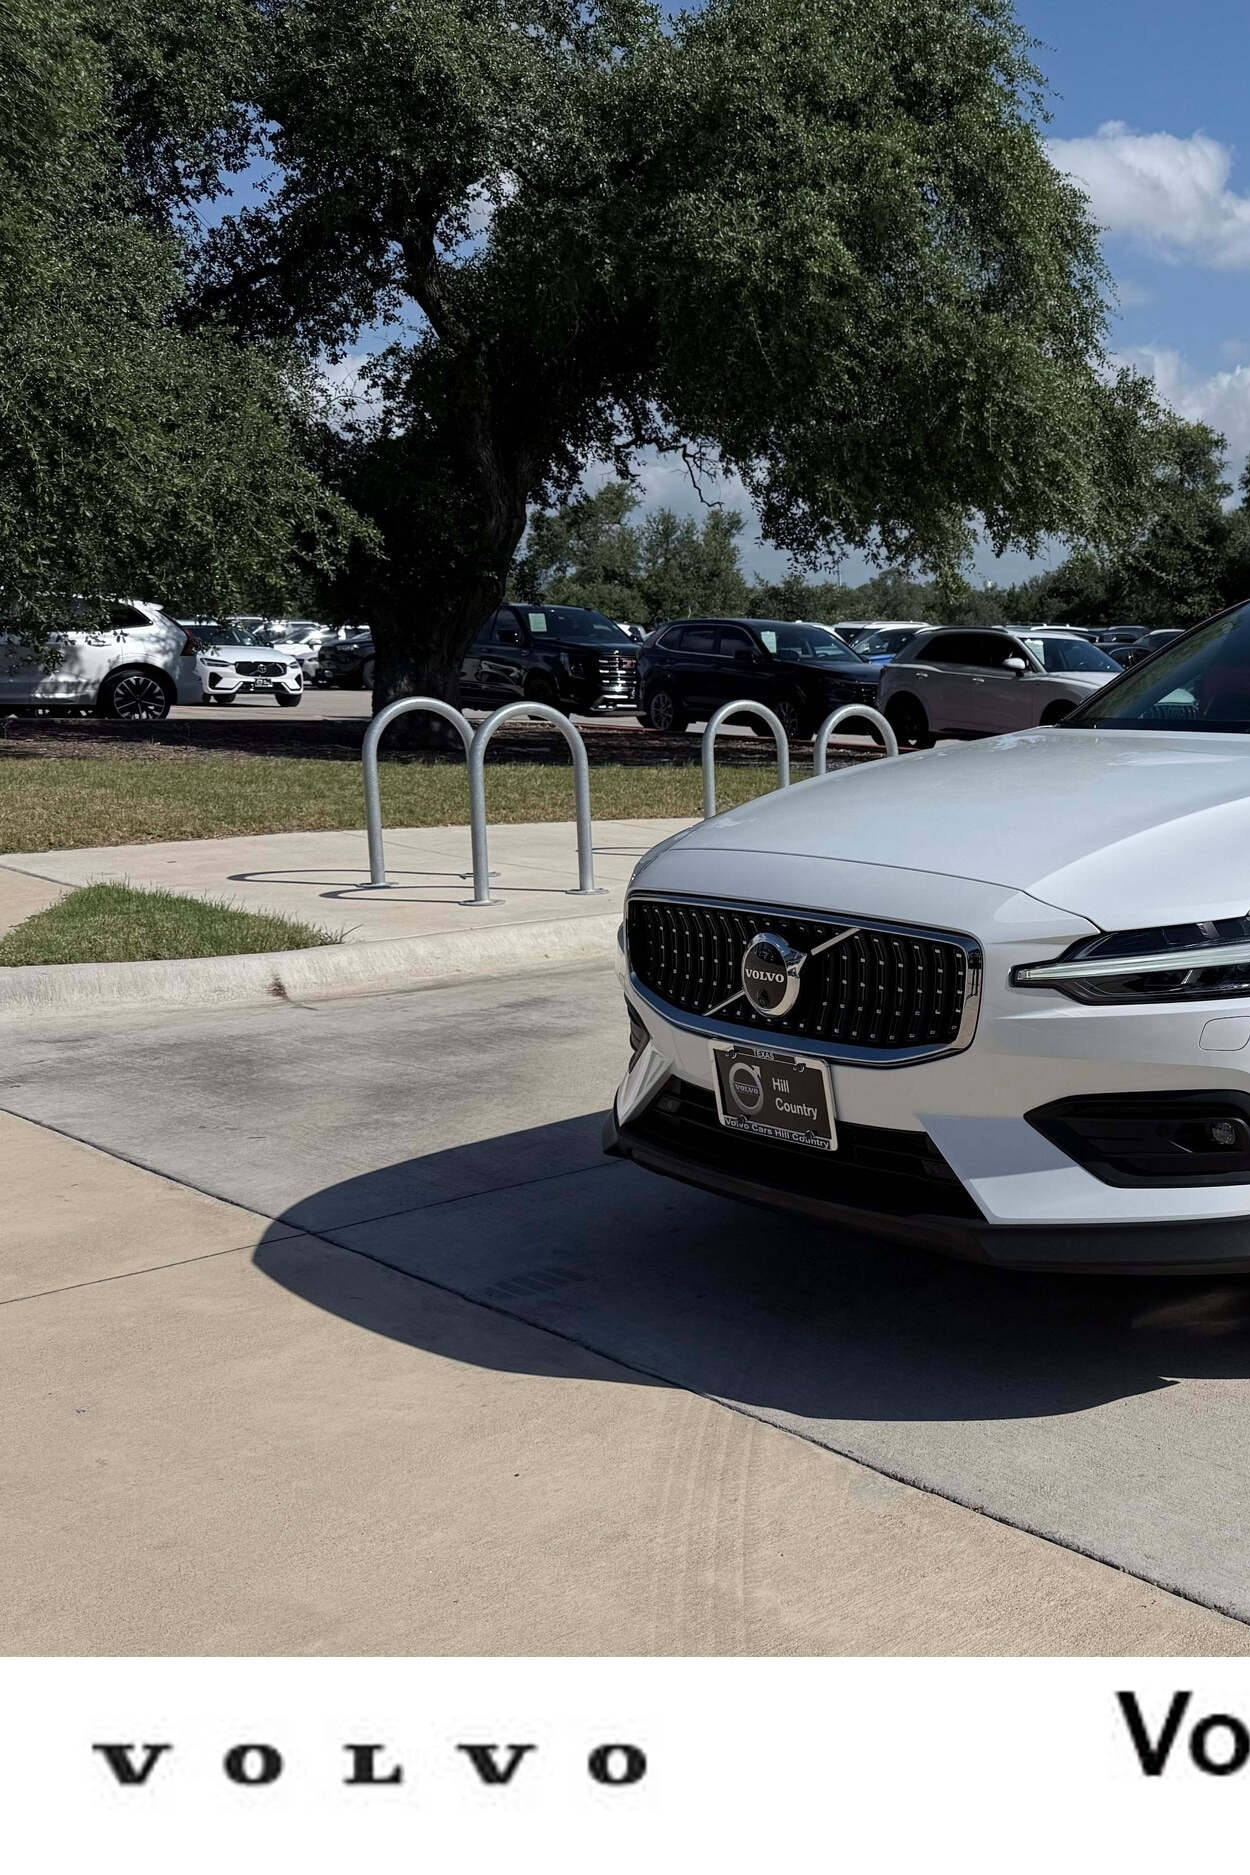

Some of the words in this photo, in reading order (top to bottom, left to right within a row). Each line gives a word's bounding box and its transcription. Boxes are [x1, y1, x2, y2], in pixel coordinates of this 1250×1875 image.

[745, 968, 785, 983] VOLVO
[753, 1049, 775, 1061] TEXAS
[735, 1084, 759, 1095] VOLVO
[772, 1077, 790, 1093] Hill
[775, 1098, 818, 1120] Country
[751, 1124, 772, 1135] Cars
[774, 1129, 790, 1139] Hill
